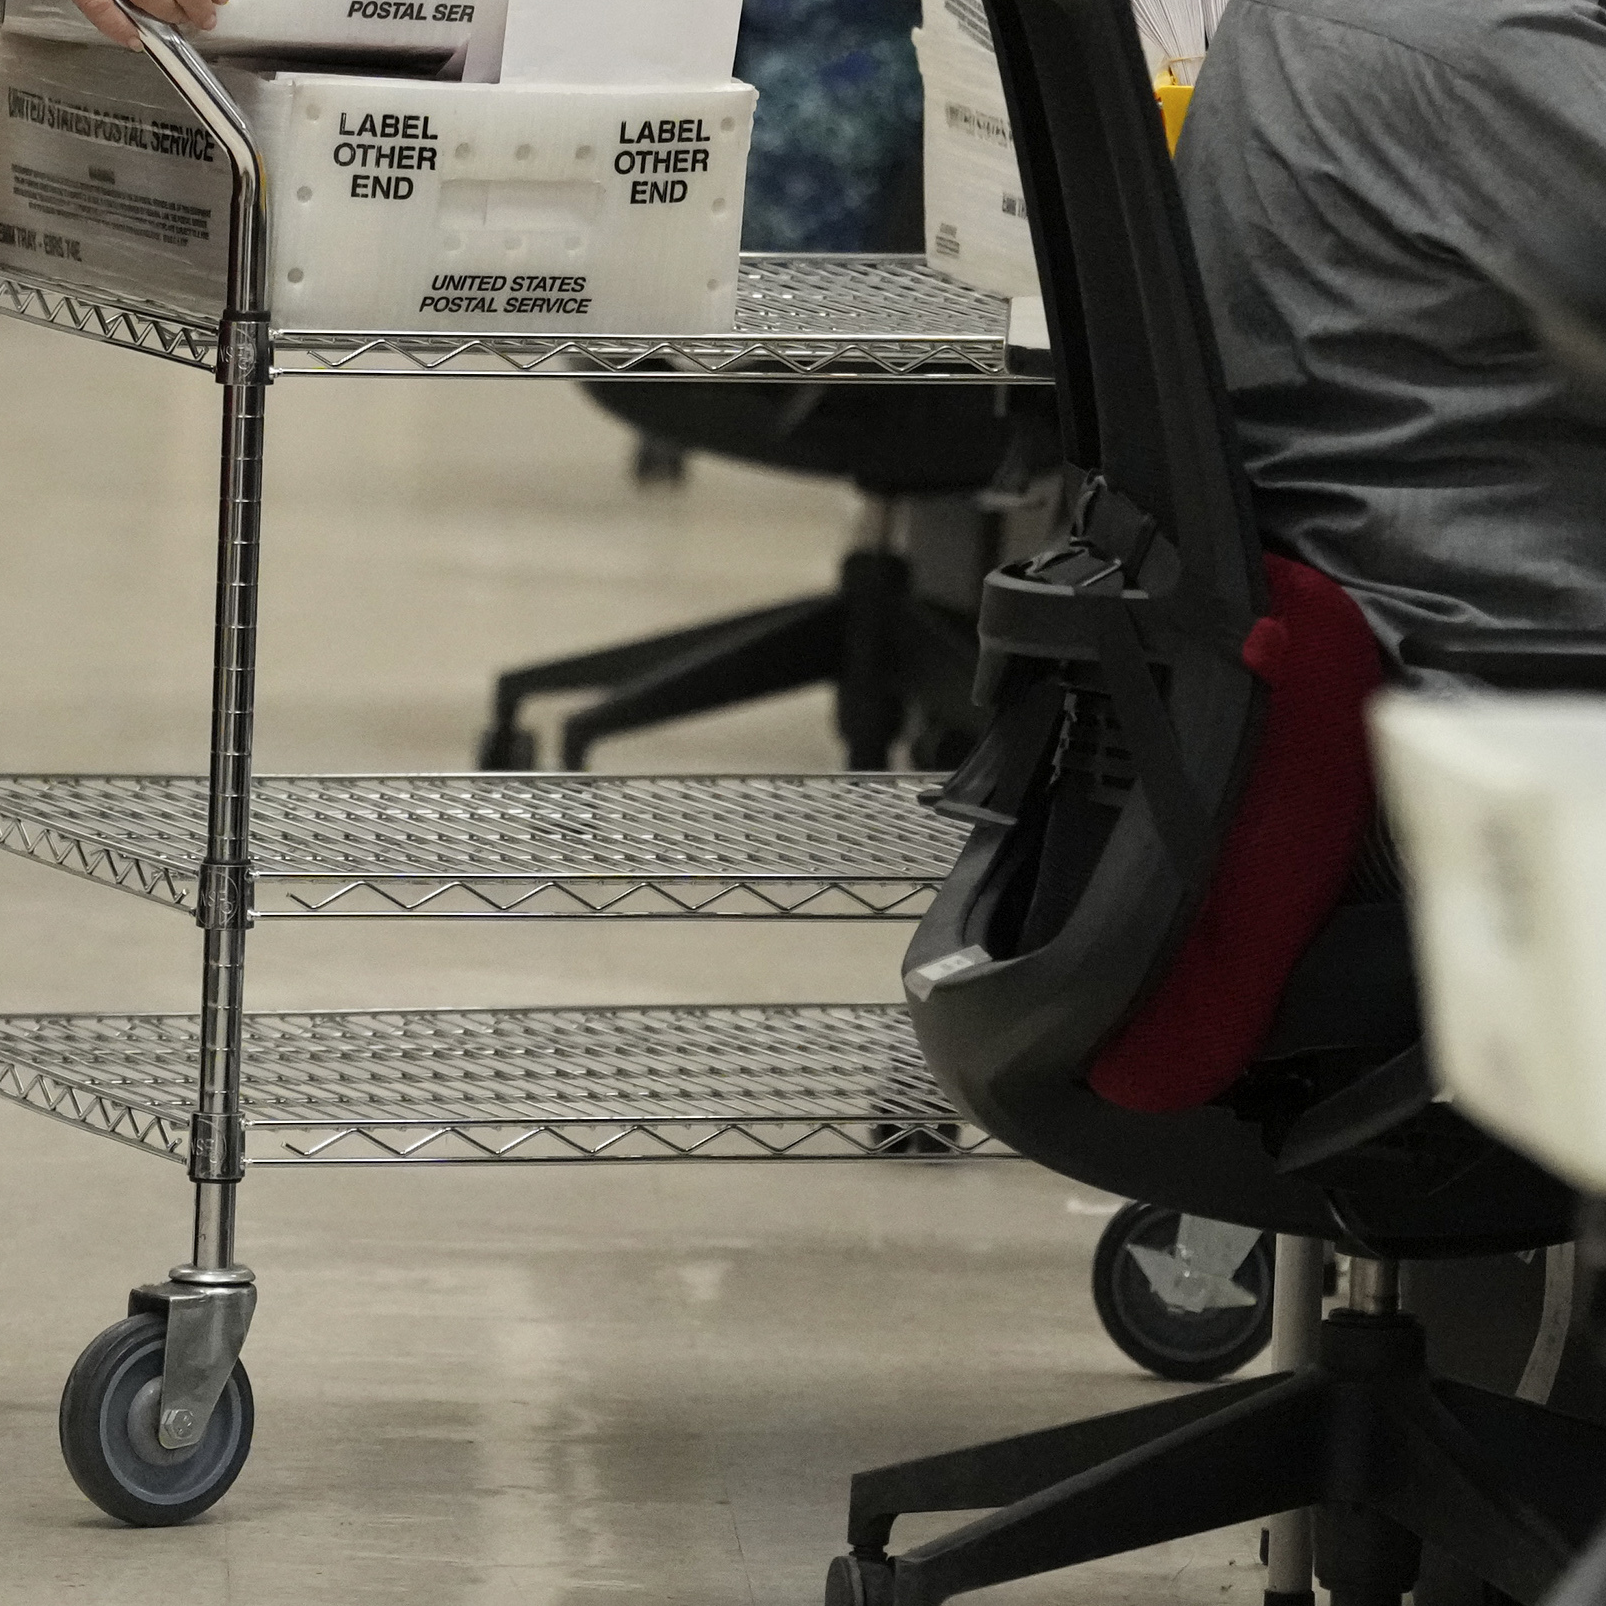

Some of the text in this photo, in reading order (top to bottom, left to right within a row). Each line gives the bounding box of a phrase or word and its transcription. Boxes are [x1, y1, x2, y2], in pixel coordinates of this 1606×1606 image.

[347, 1, 427, 21] POSTAL
[8, 86, 215, 162] UNITED STATES POSTAL SERVICE
[339, 112, 438, 140] LABEL
[619, 119, 710, 144] LABEL
[333, 142, 437, 170] OTHER
[613, 149, 709, 174] OTHER
[351, 174, 414, 200] END
[630, 179, 688, 204] END
[432, 275, 586, 293] UNITED STATES
[419, 296, 592, 315] POSTAL SERVICE
